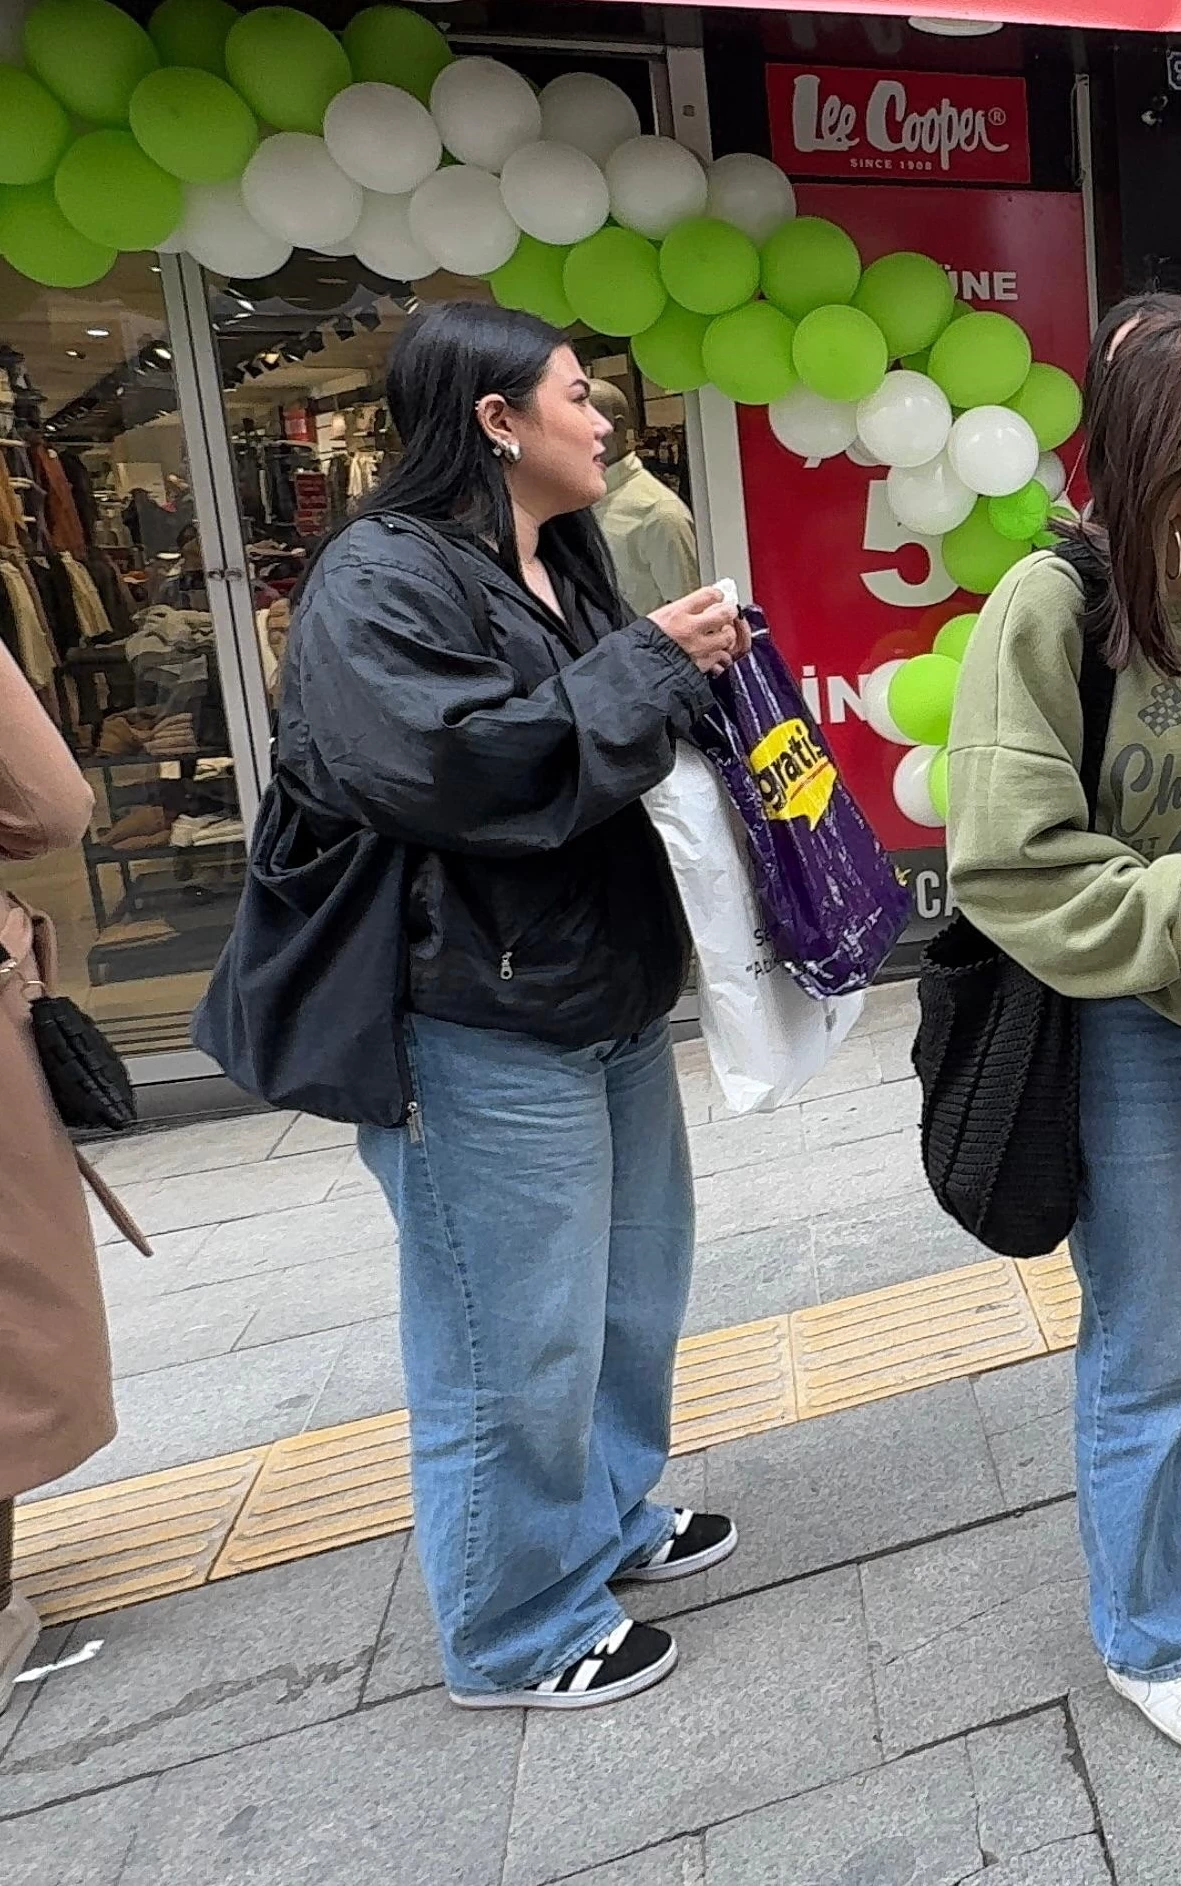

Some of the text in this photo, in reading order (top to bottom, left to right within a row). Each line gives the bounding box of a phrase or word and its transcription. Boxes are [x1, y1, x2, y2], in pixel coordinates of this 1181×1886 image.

[792, 74, 860, 152] Lee
[850, 158, 933, 171] SINCE 1908
